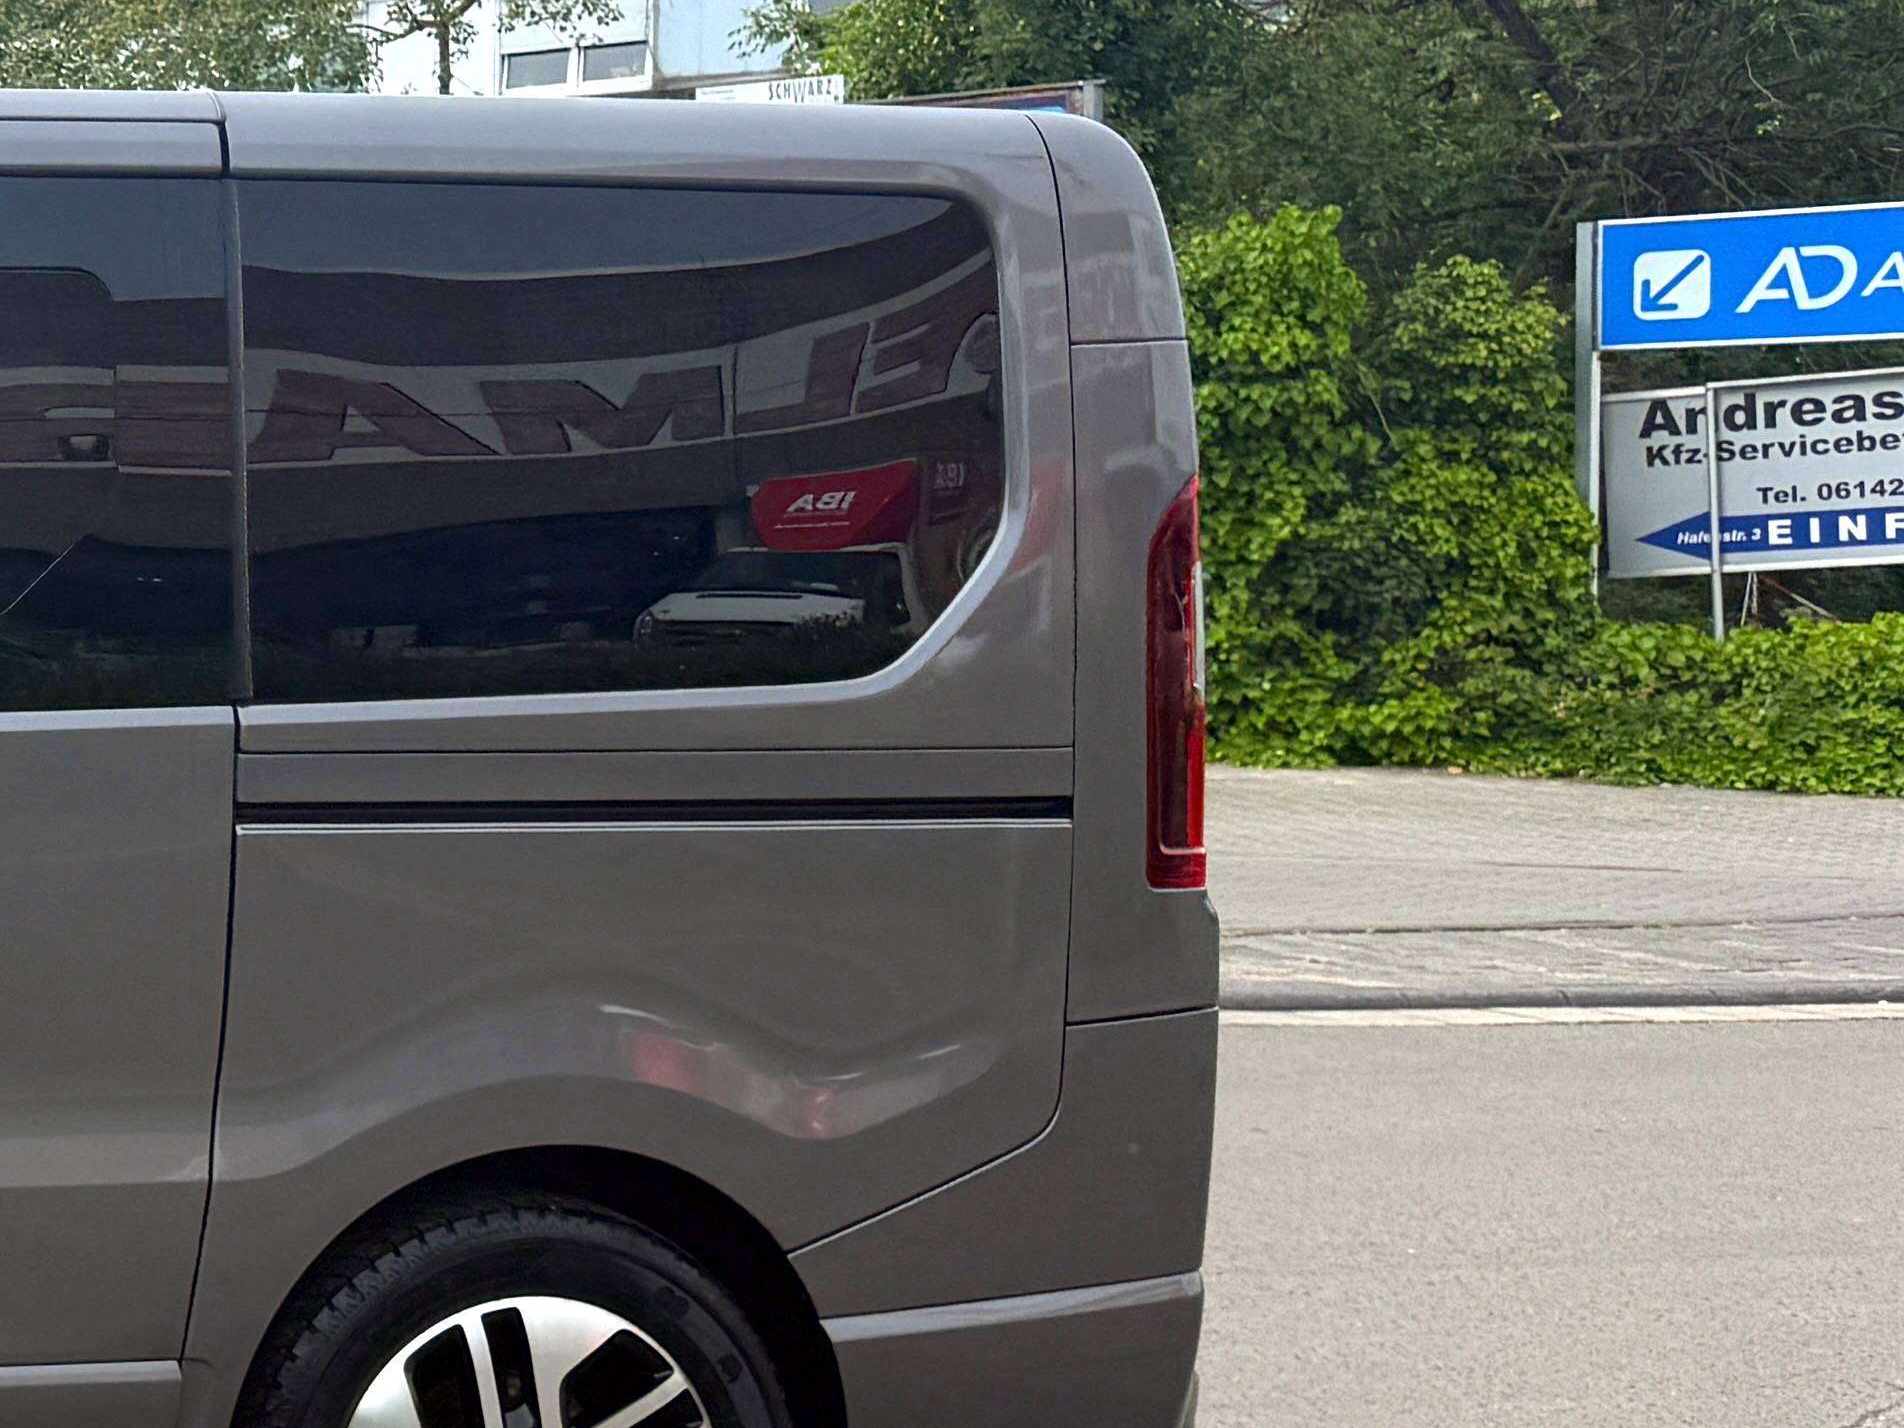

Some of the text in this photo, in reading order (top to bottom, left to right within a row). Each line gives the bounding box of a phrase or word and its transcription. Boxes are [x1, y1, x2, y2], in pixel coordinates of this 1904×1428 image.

[768, 78, 832, 103] SCHWARZ
[1645, 431, 1904, 468] Kfz-Servicebe
[1757, 478, 1904, 505] Tel. 06142
[1676, 528, 1747, 546] Hafestr.
